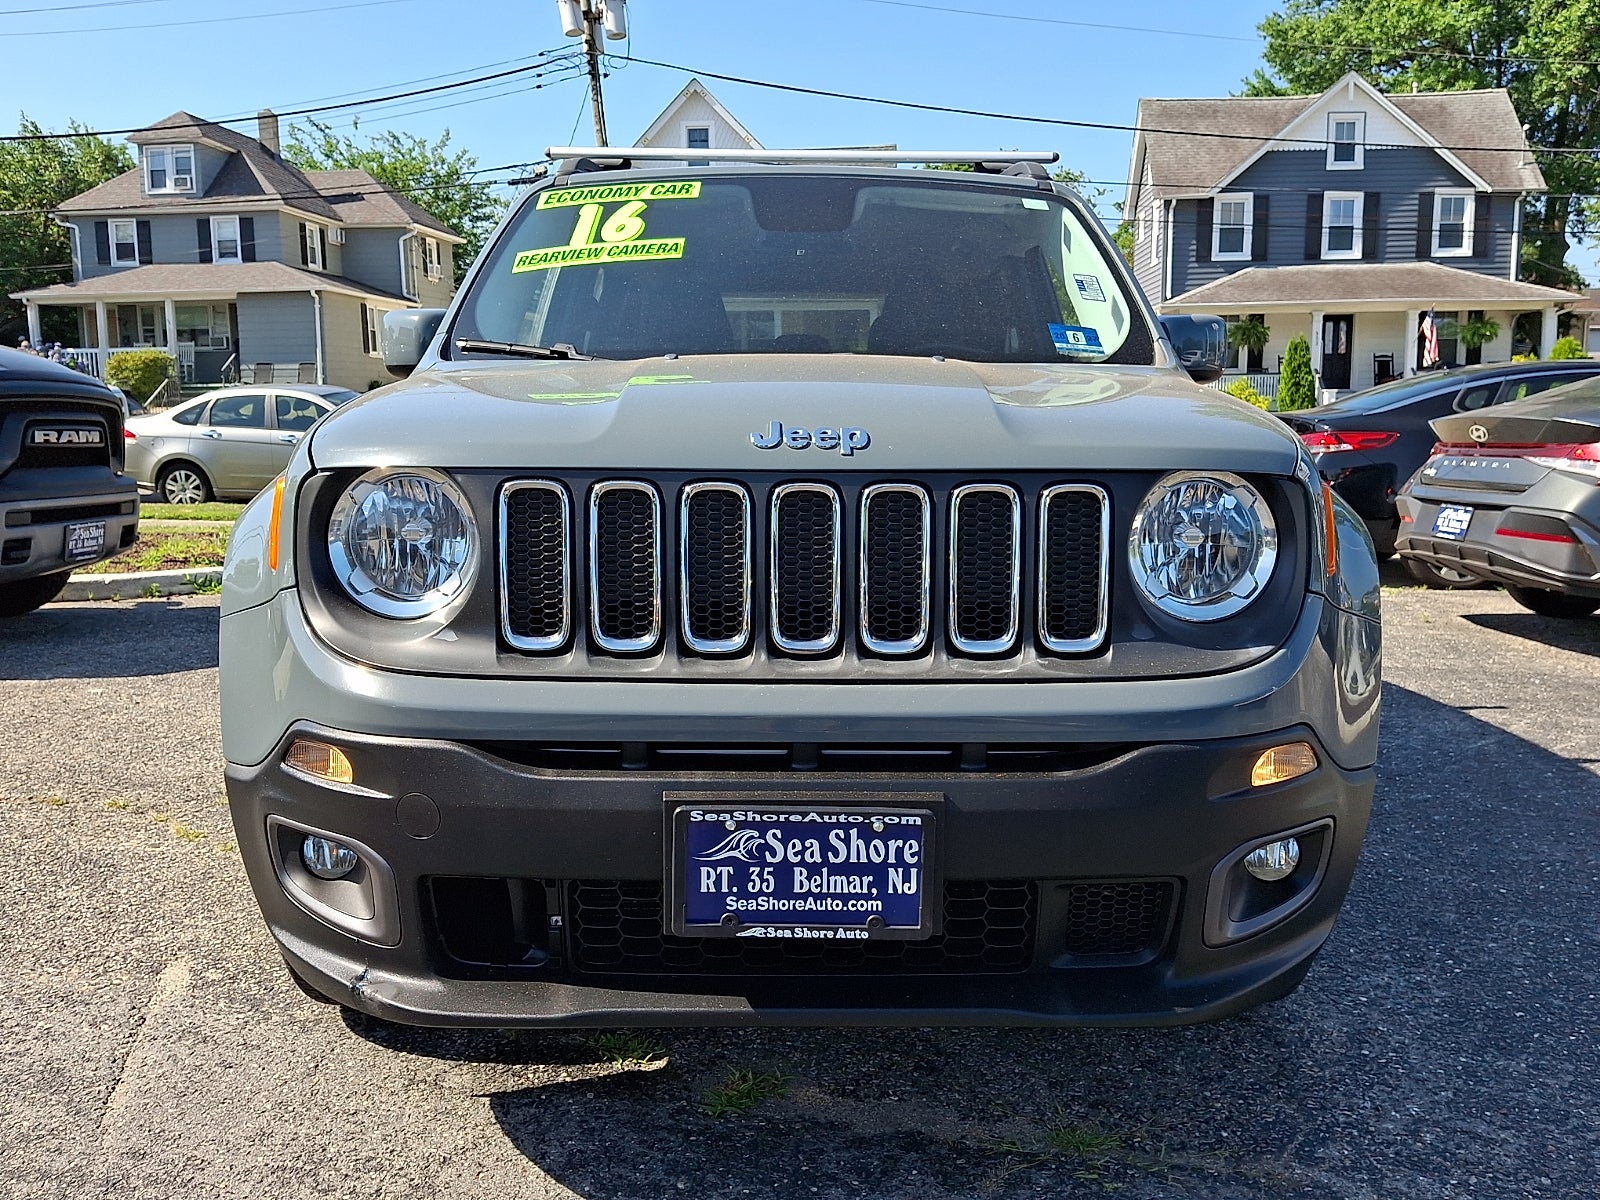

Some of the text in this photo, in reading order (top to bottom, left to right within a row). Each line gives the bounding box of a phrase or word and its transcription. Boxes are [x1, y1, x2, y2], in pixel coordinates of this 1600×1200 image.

[543, 183, 695, 205] ECONOMY CAR
[569, 200, 648, 246] 16
[516, 242, 682, 268] REARVIEW CAMERA
[1072, 332, 1080, 343] 6
[34, 430, 100, 443] RAM
[750, 420, 871, 457] Jeep
[690, 810, 922, 825] SeaShoreAuto.com
[765, 827, 919, 864] Sea Shore
[700, 866, 918, 897] RT. 35 Belmar, NJ
[725, 896, 883, 912] SeaShoreAuto.com
[766, 927, 869, 940] Sea Shore Auto
